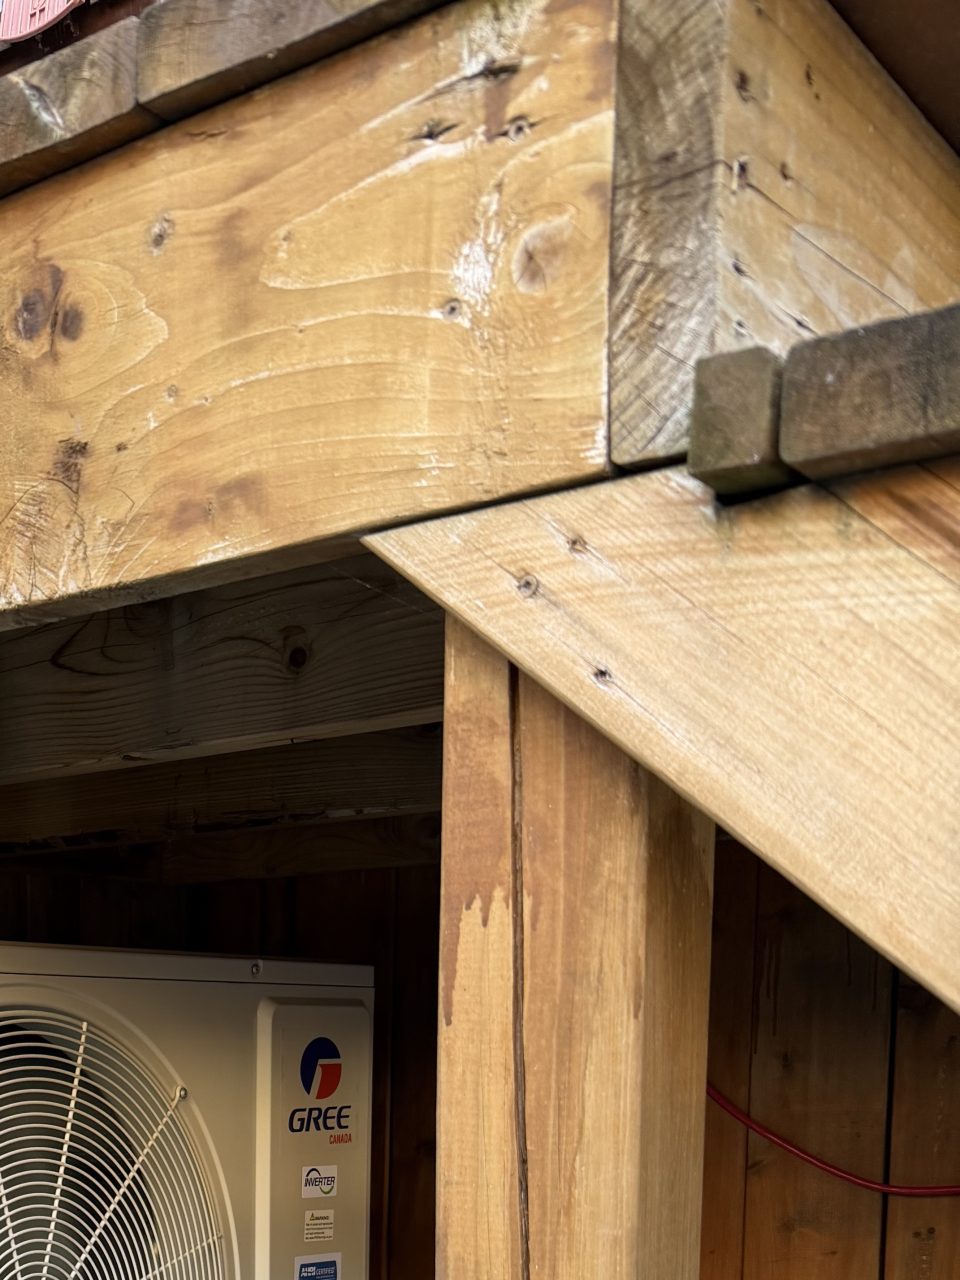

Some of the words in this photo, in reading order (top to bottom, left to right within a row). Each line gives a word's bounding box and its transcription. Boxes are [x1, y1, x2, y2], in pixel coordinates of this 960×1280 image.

[288, 1105, 351, 1133] GREE
[329, 1133, 352, 1145] CANADA
[304, 1176, 336, 1187] INVERTER
